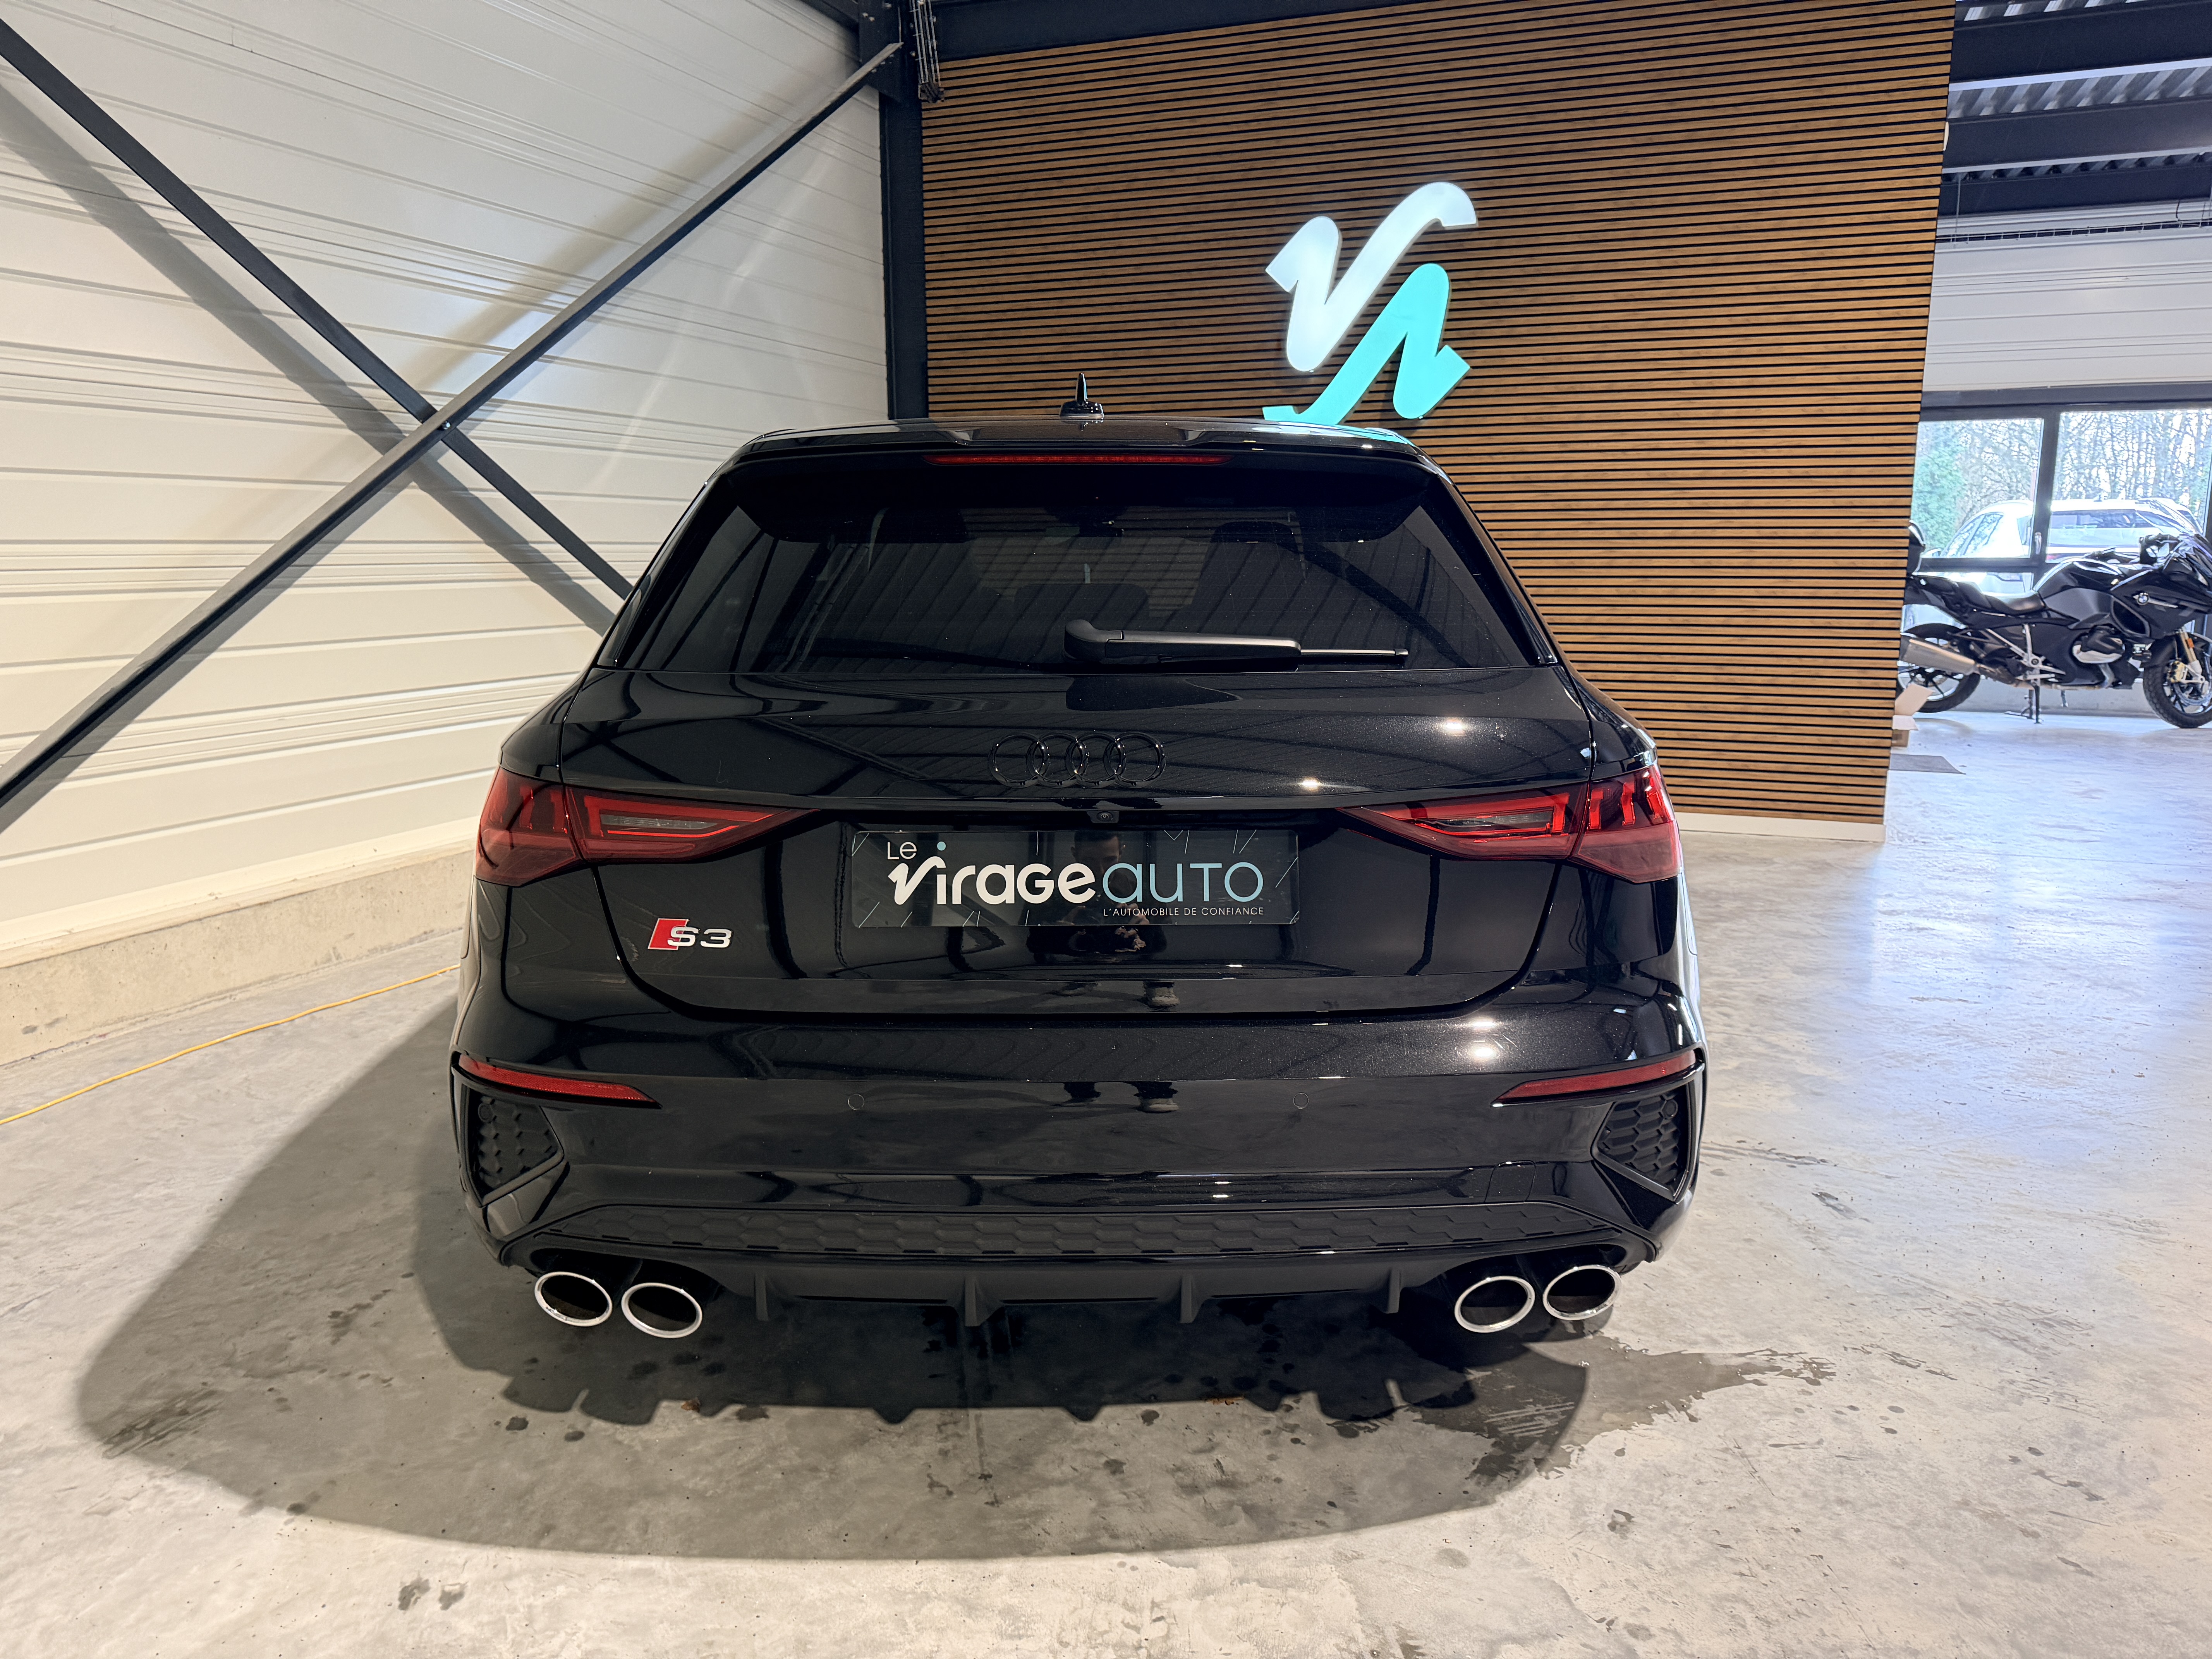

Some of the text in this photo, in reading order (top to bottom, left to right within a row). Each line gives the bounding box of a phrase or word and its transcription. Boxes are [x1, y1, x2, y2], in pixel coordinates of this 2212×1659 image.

[1103, 907, 1264, 917] L'AUTOMOBILE DE CONFIANCE
[667, 926, 733, 948] S3
